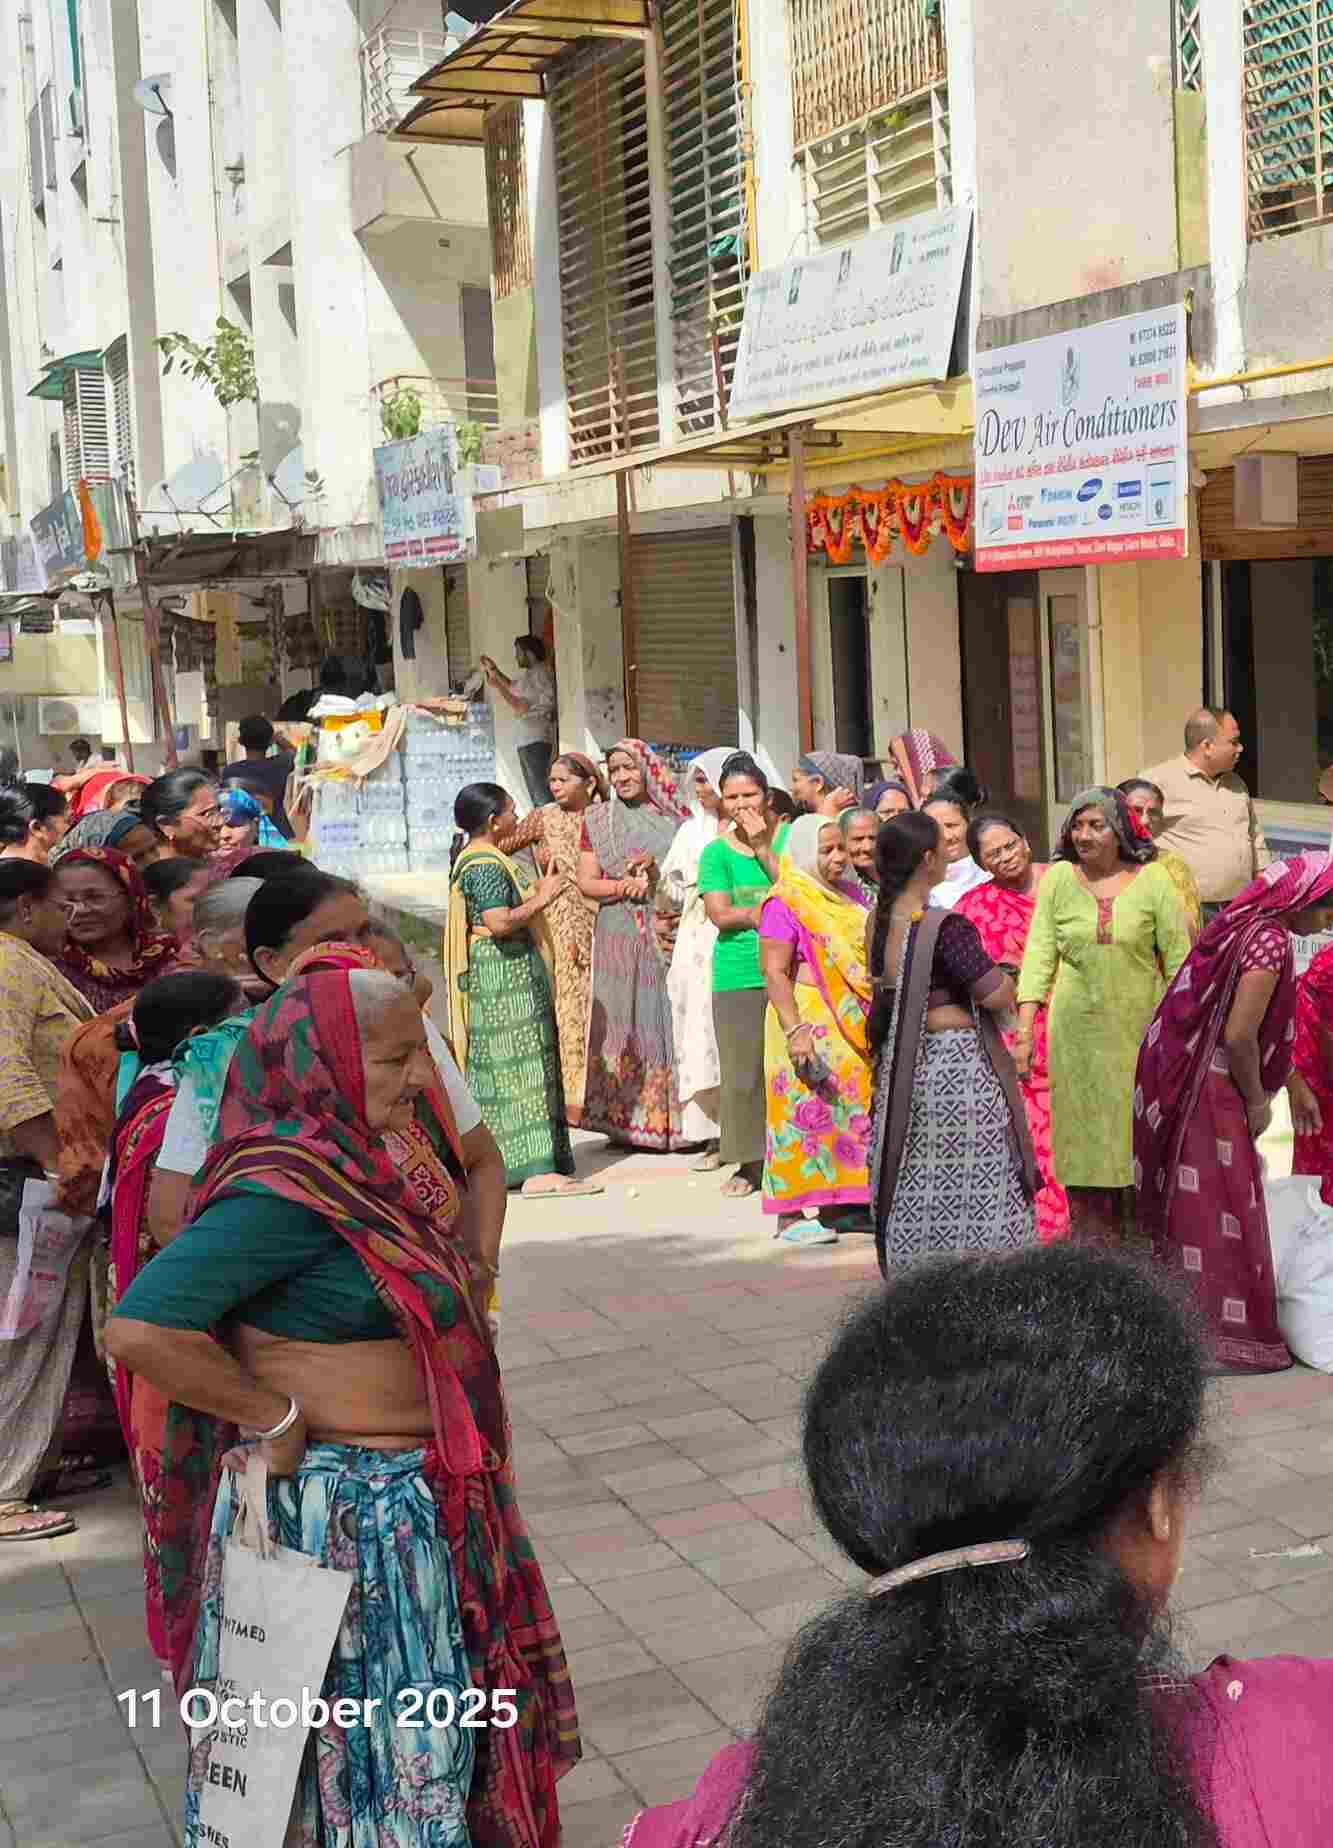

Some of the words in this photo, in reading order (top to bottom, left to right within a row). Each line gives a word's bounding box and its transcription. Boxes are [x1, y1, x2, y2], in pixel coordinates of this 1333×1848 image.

[978, 408, 1027, 457] Dev
[1027, 411, 1061, 455] Air
[1061, 396, 1177, 448] Conditioners
